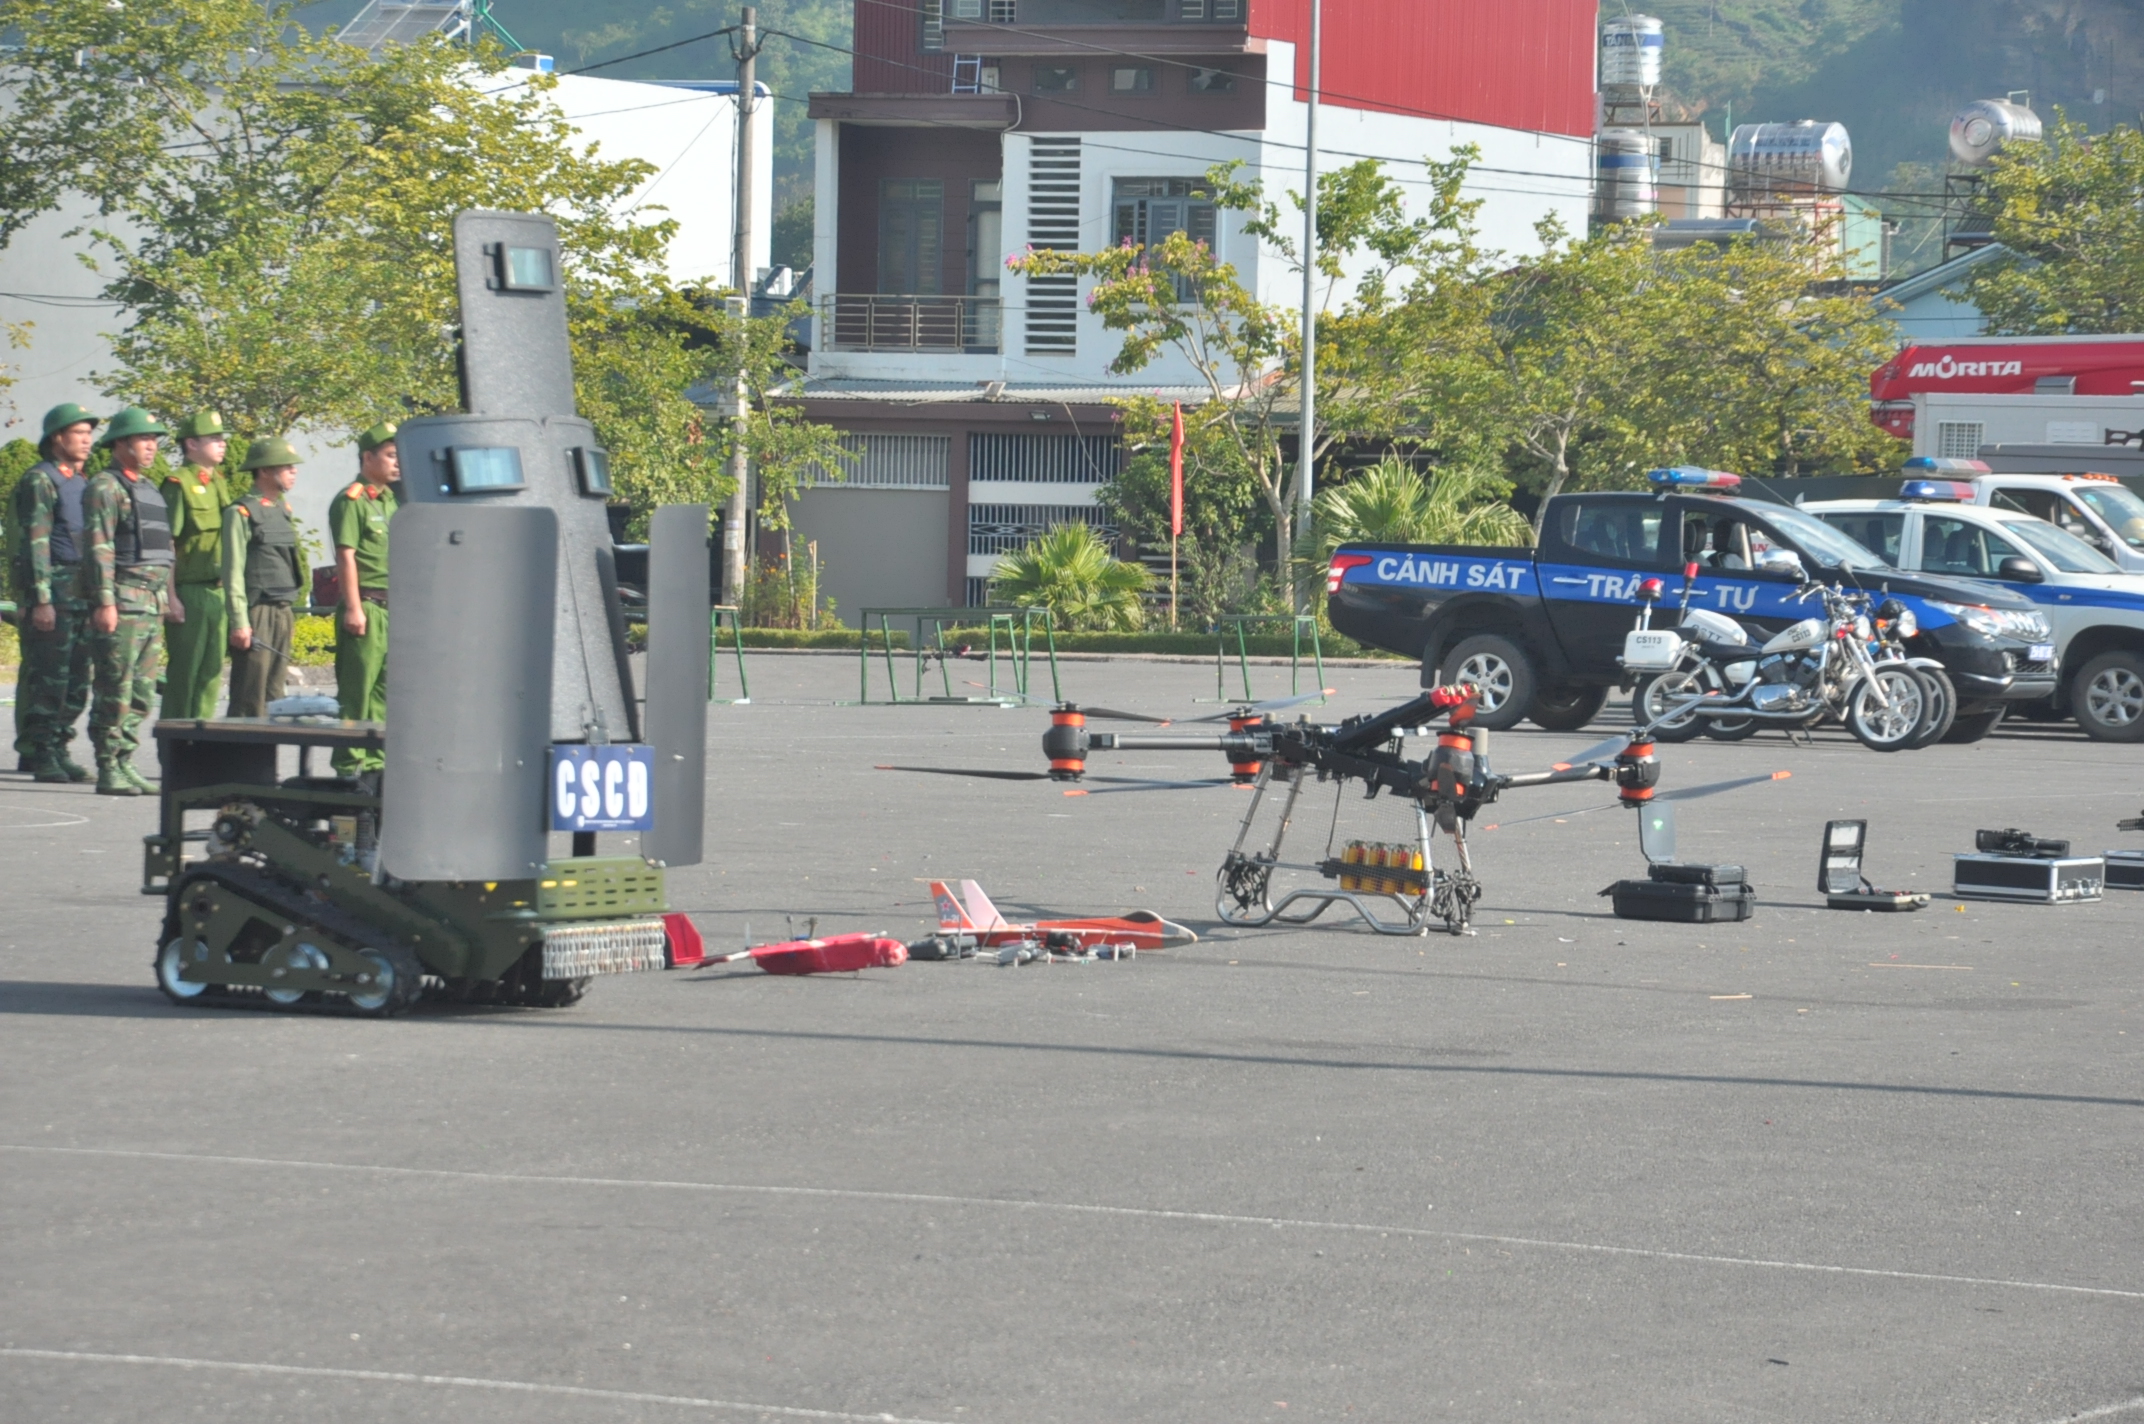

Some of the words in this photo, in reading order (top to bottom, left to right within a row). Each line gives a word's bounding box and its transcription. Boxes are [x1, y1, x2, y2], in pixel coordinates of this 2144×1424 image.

[1908, 355, 2022, 379] MORITA
[1377, 553, 1460, 585] CẢNH
[1466, 561, 1526, 589] SÁT
[1587, 573, 1664, 603] TRẬ
[1715, 585, 1760, 613] TỰ
[1636, 636, 1662, 645] CS113
